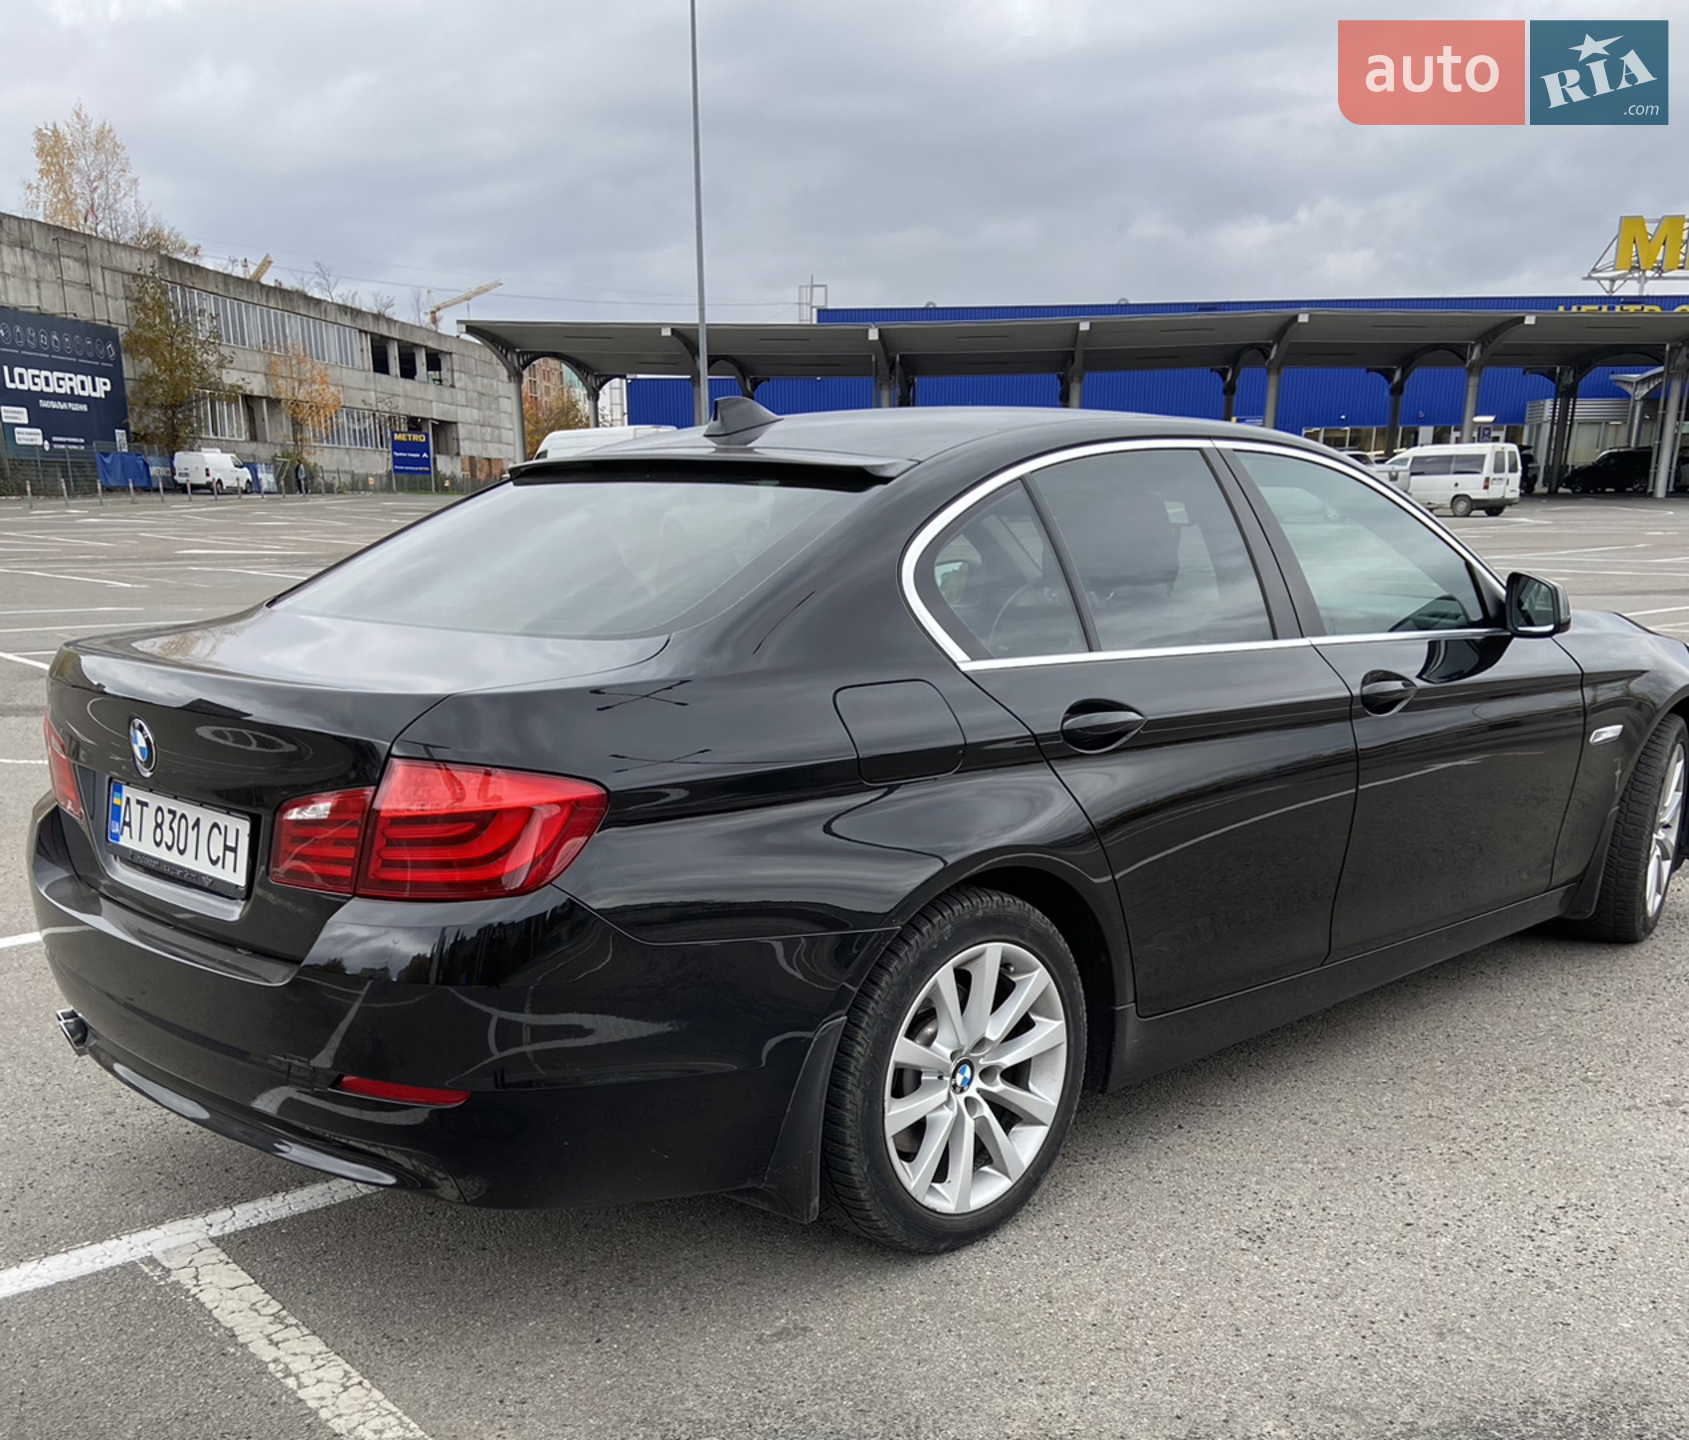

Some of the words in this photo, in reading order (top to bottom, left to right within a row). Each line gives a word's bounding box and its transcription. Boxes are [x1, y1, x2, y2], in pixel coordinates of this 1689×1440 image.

[1615, 214, 1689, 271] M
[3, 365, 112, 398] LOGOGROUP
[394, 433, 427, 442] METRO
[120, 796, 149, 842] AT
[153, 805, 201, 861] 8301
[207, 821, 240, 874] CH
